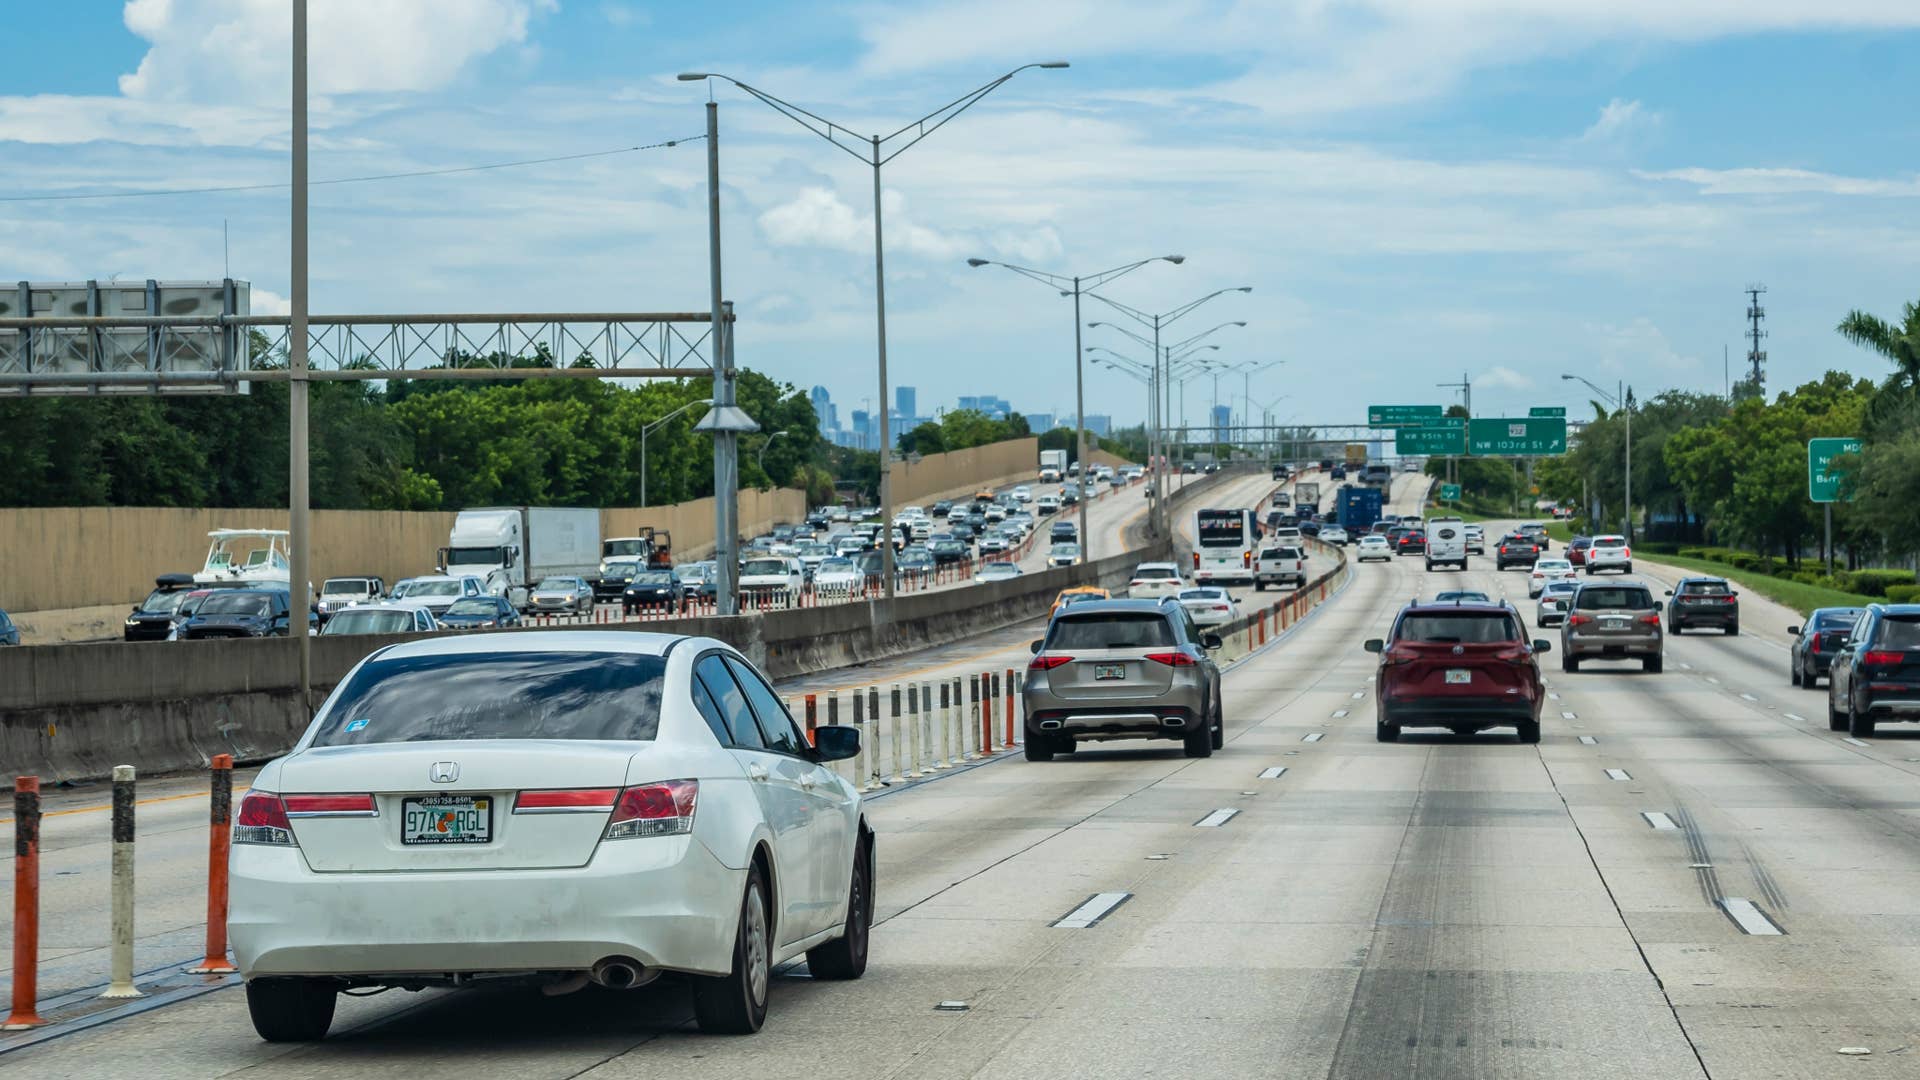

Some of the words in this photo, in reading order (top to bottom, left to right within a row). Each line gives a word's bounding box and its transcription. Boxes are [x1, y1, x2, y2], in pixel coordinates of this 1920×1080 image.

[1476, 441, 1491, 449] NW
[1497, 441, 1526, 449] 103rd
[1532, 441, 1543, 449] St
[1816, 474, 1840, 485] Barr
